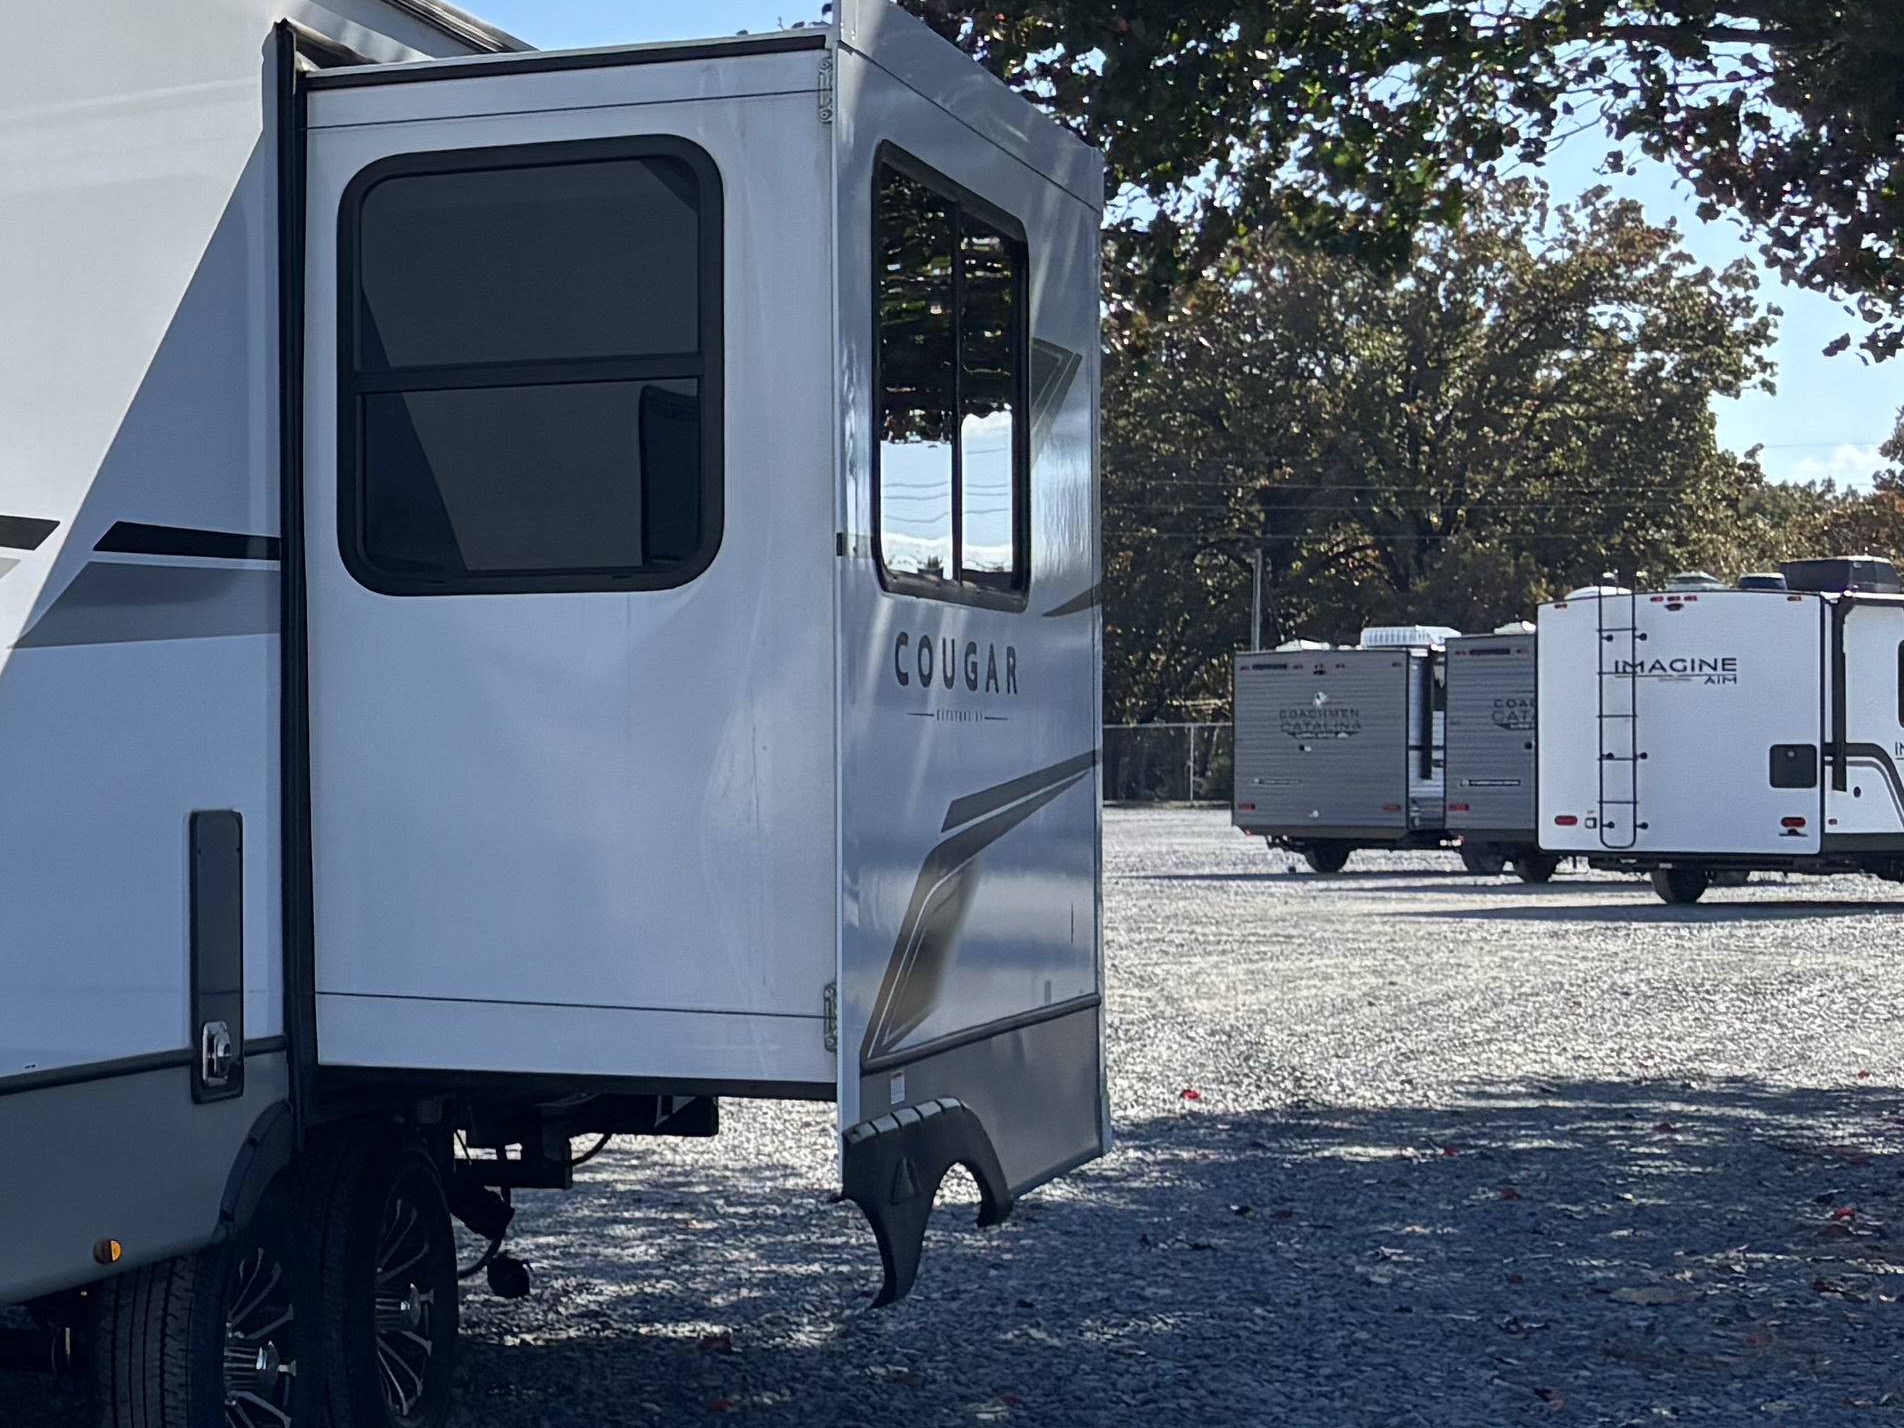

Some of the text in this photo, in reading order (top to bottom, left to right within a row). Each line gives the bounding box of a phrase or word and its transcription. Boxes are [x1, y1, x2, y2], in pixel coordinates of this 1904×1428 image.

[894, 631, 1018, 695] COUGAR
[1614, 657, 1737, 674] IMAGINE
[1703, 674, 1737, 685] AIM
[1491, 710, 1535, 722] CAT
